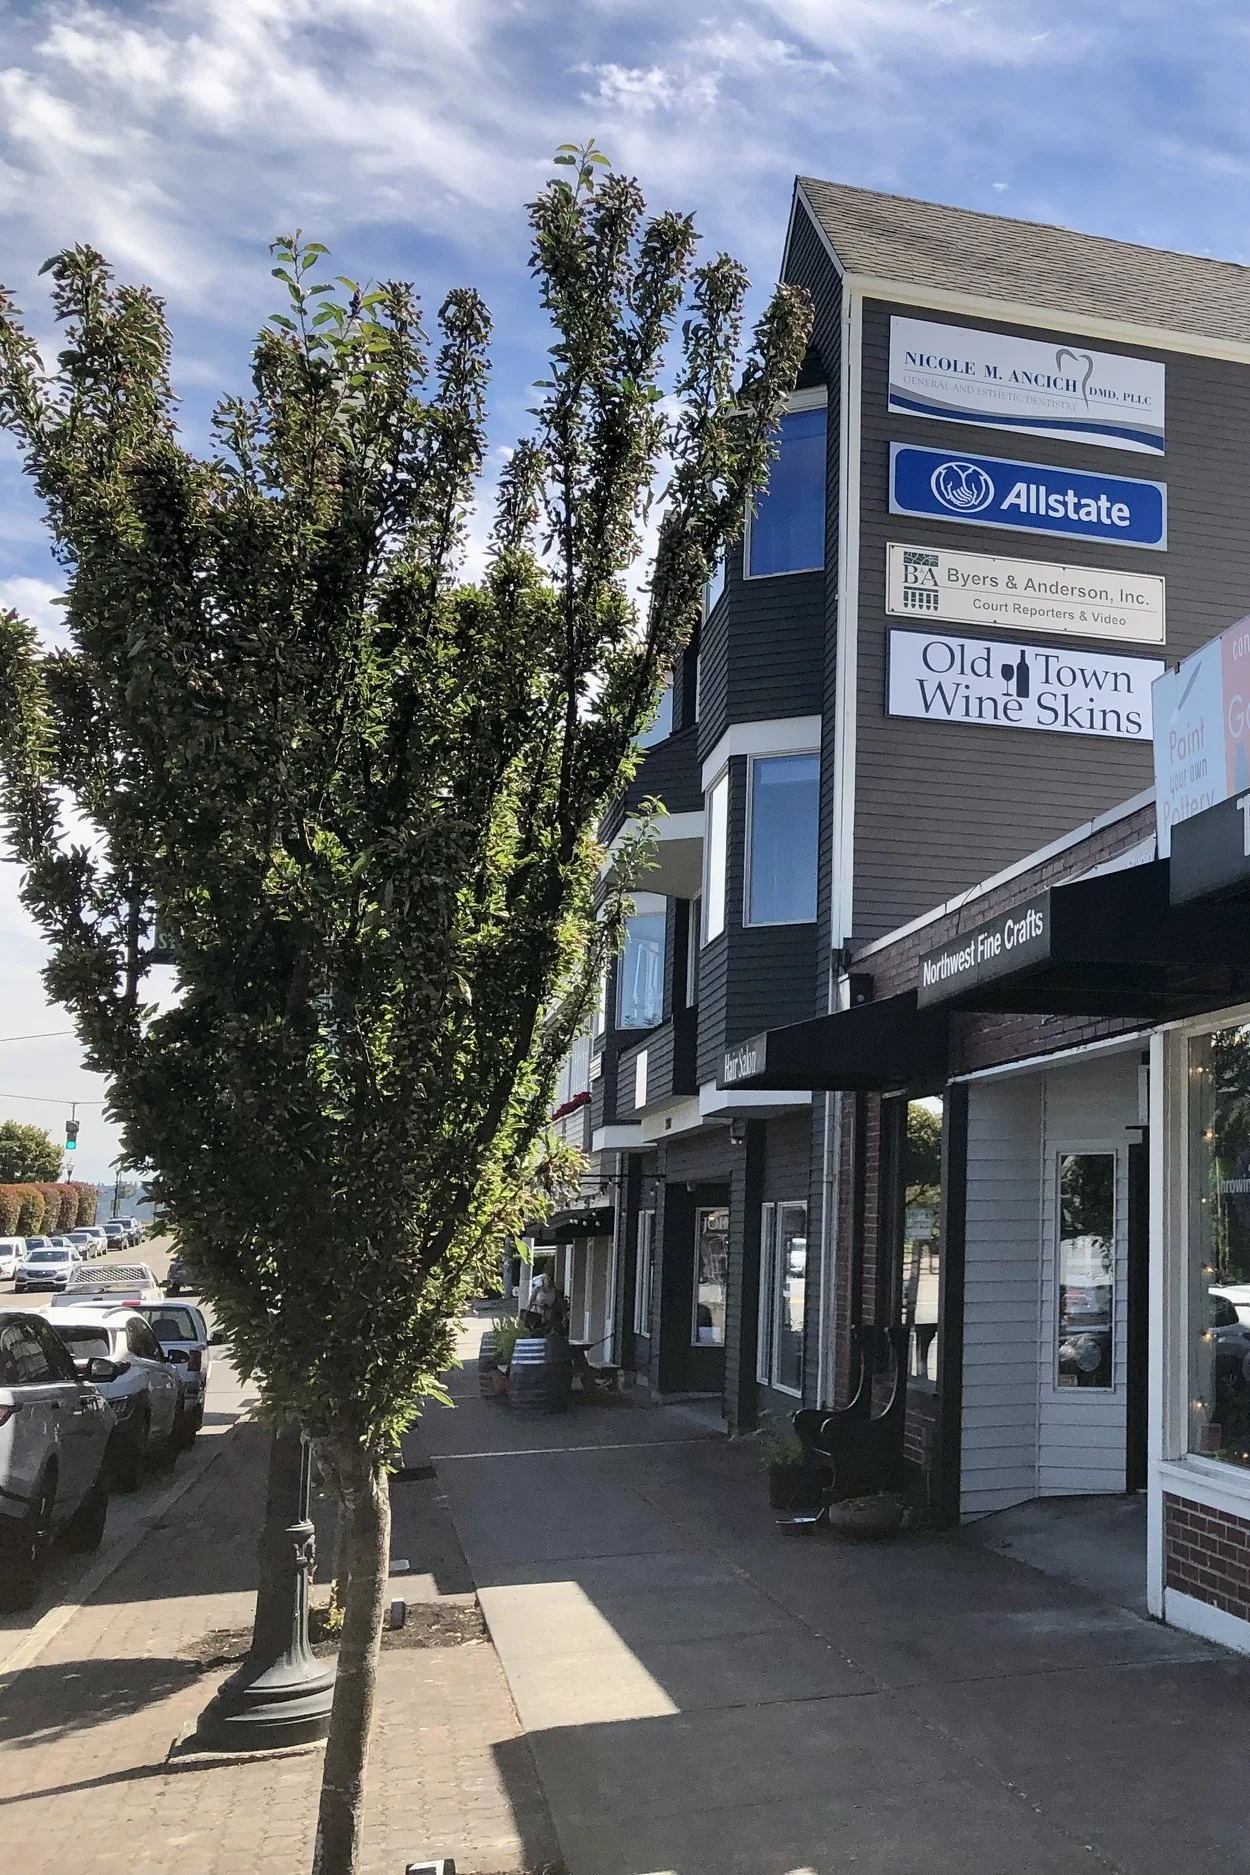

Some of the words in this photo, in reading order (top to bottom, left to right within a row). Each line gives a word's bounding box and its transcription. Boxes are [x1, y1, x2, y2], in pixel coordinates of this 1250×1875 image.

[903, 375, 950, 391] GENERAL
[952, 382, 975, 395] AND
[977, 386, 1023, 402] ESTHETIC
[1025, 395, 1077, 412] DENTISTRY
[904, 351, 976, 376] NICOLE
[983, 364, 1003, 381] M.
[1008, 369, 1077, 393] ANCICH
[1123, 392, 1152, 406] PLLC
[1000, 482, 1131, 527] Allstate
[947, 567, 999, 588] Byers
[1005, 574, 1018, 590] &
[1023, 577, 1114, 604] Anderson,
[1119, 588, 1150, 606] Inc.
[973, 598, 1009, 613] Court
[1012, 602, 1075, 621] Reporters
[1079, 610, 1088, 622] &
[1092, 612, 1127, 626] Video
[922, 641, 994, 680] Old
[1034, 652, 1135, 695] Town
[915, 678, 1024, 723] Wine
[1036, 691, 1142, 736] Skins
[1168, 717, 1206, 766] Paint
[1169, 768, 1187, 801] your
[1189, 757, 1208, 783] own
[923, 940, 976, 987] Northwest
[978, 932, 1002, 963] Fine
[1004, 909, 1044, 950] Crafts
[724, 1052, 737, 1083] Hair
[738, 1044, 757, 1078] Salon
